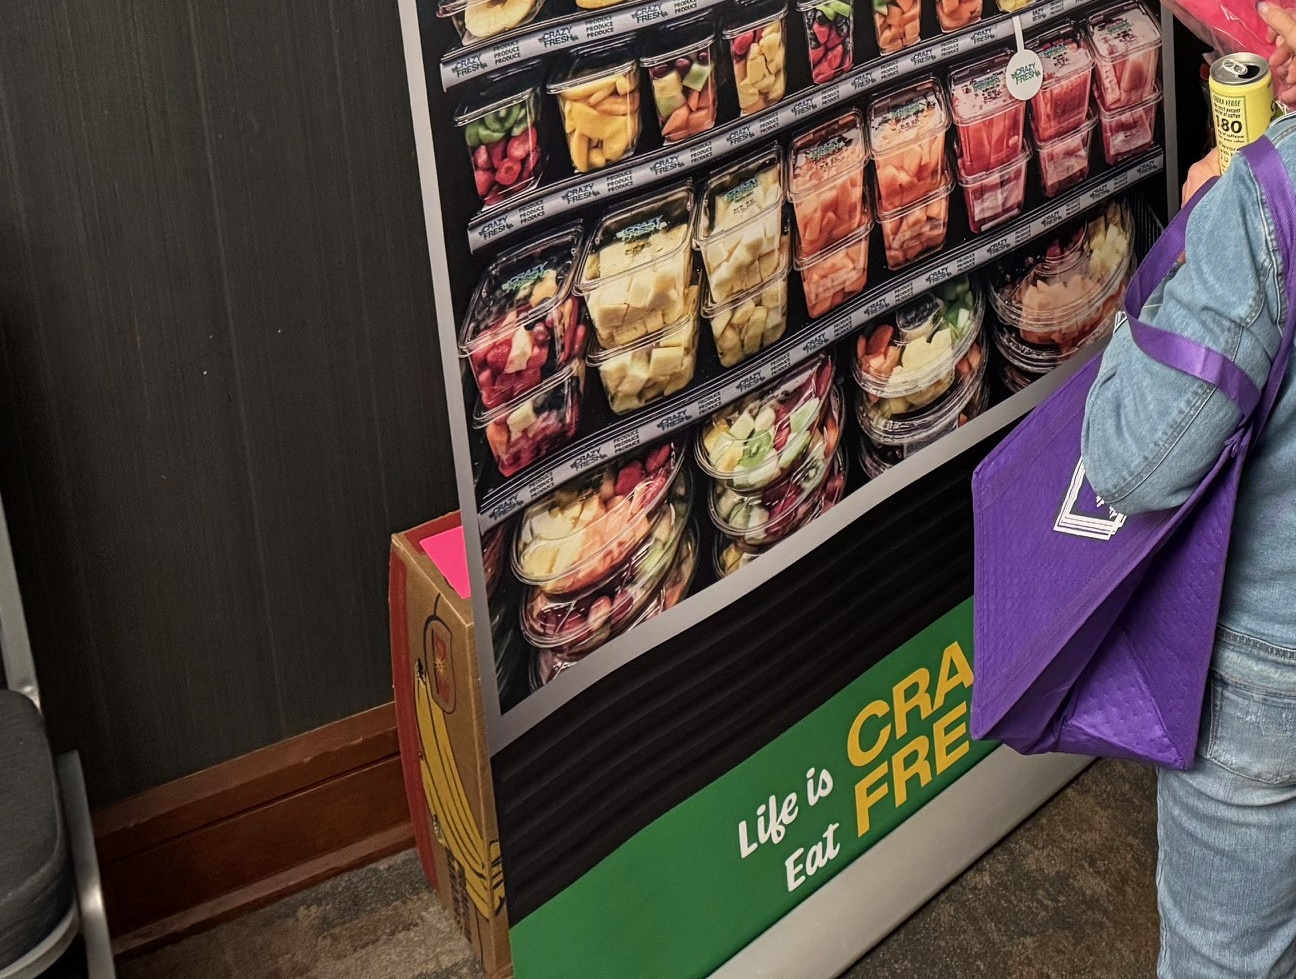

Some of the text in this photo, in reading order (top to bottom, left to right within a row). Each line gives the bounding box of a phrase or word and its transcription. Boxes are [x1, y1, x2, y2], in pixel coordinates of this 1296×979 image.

[544, 26, 572, 41] CRAZY
[544, 34, 573, 48] FRESH
[1215, 114, 1242, 134] 180
[738, 640, 975, 859] Life is CRA
[785, 701, 970, 893] Eat FRE
